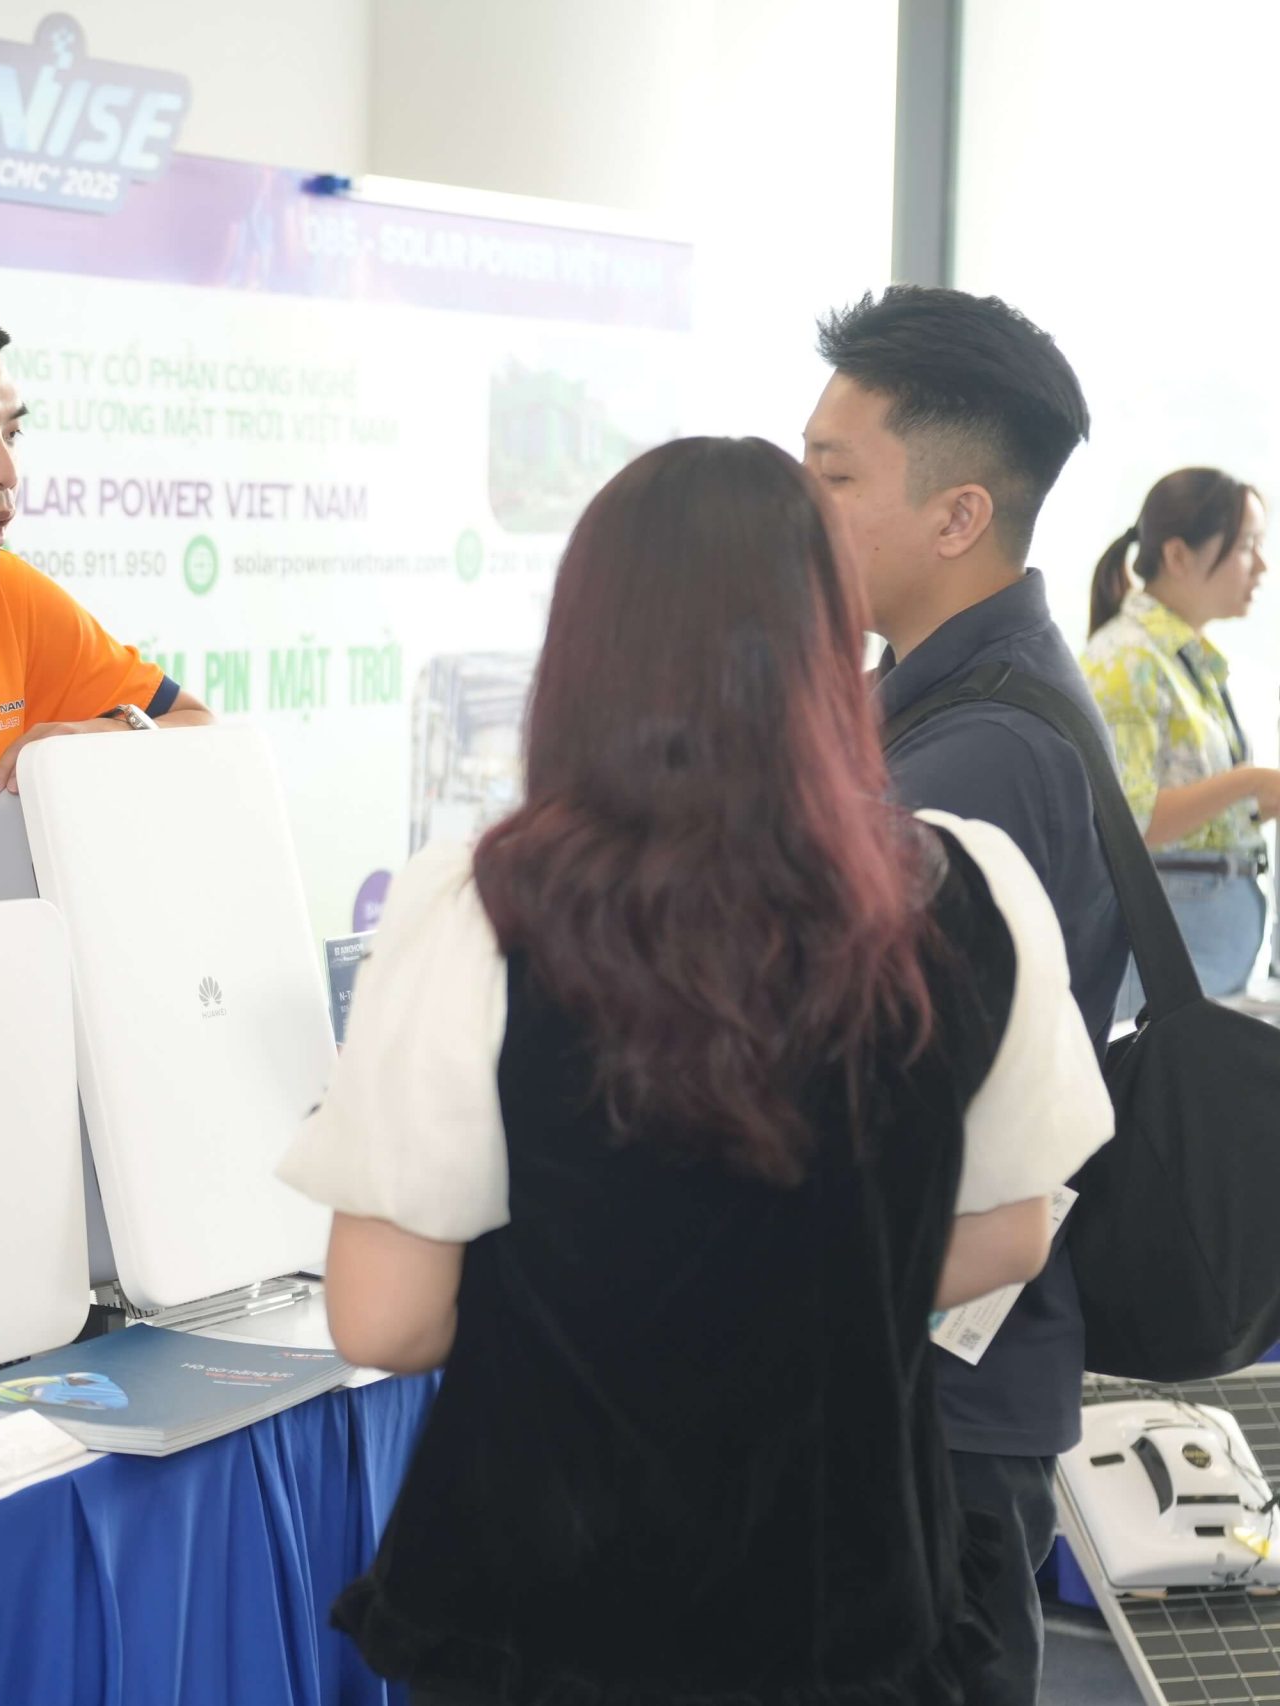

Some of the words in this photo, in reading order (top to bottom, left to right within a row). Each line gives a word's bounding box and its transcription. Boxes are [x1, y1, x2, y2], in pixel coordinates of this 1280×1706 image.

[61, 168, 121, 201] 2025
[17, 476, 87, 518] LAR
[99, 476, 214, 519] POWER
[224, 481, 294, 520] VIET
[304, 481, 368, 521] NAM
[205, 648, 252, 714] PIN
